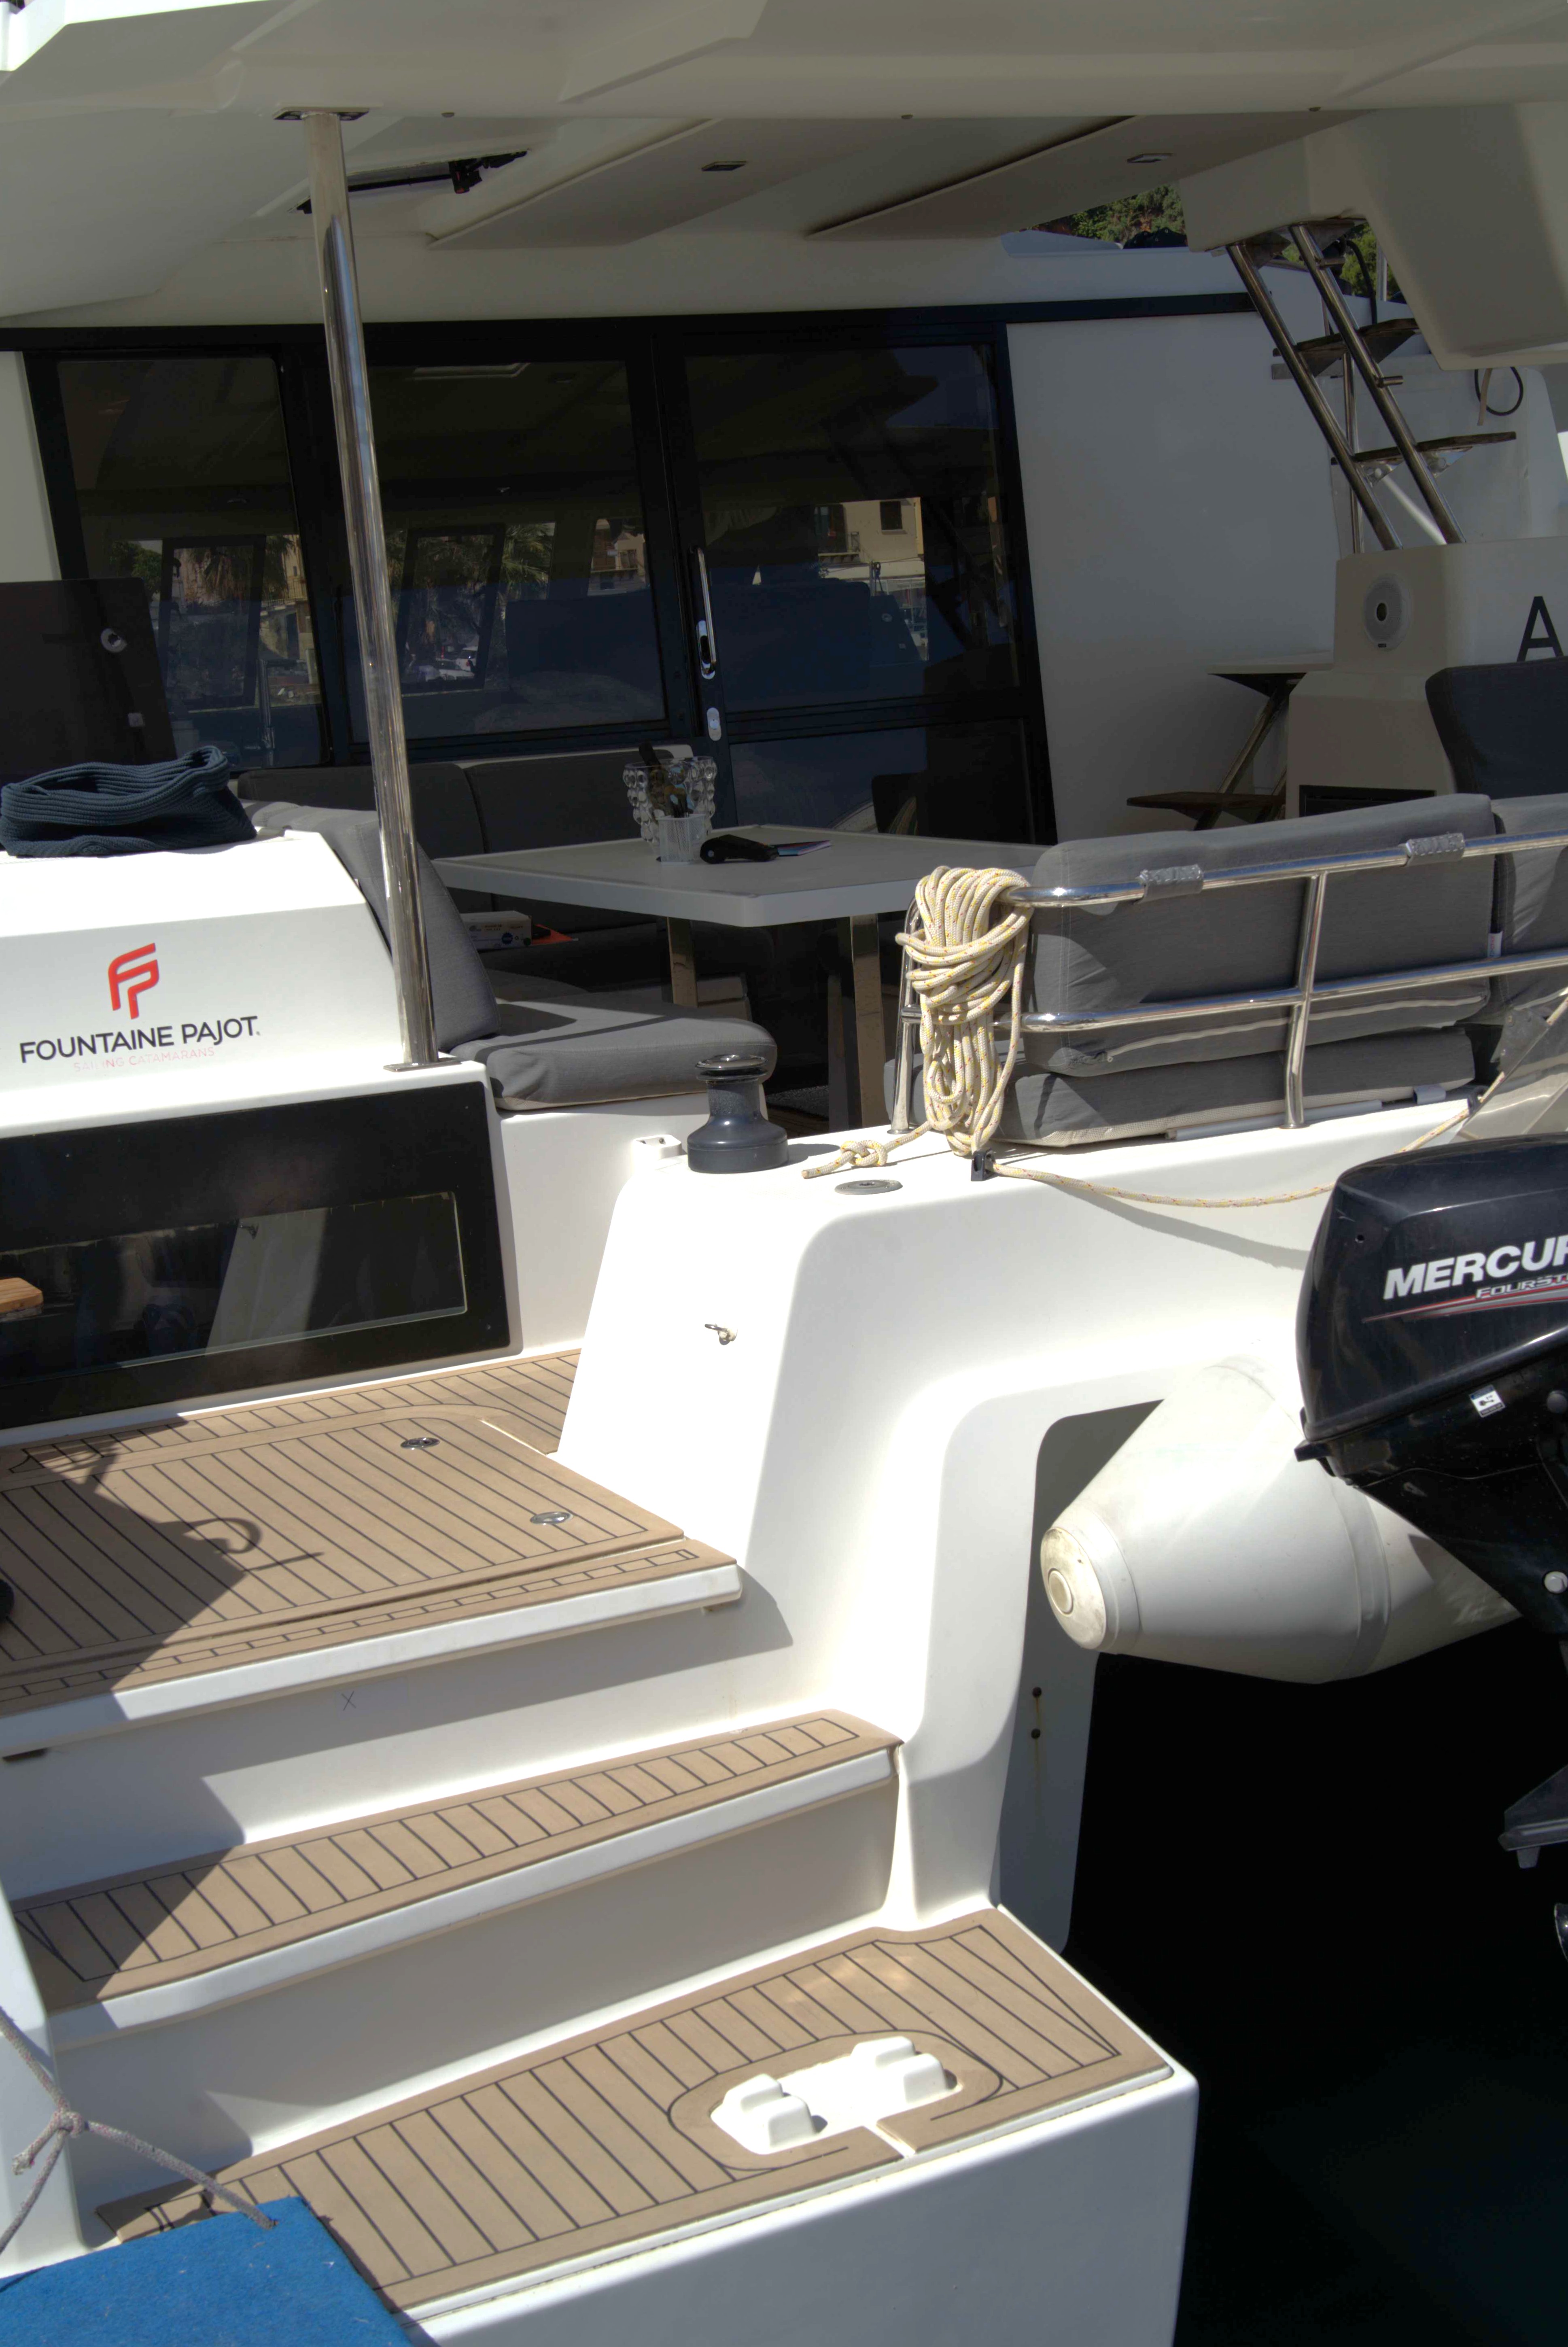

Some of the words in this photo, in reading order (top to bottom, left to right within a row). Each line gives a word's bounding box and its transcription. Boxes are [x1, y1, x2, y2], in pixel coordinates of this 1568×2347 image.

[1517, 596, 1564, 663] A
[19, 1025, 174, 1063] FOUNTAINE
[128, 1046, 215, 1066] CATAMARANS
[1476, 1273, 1568, 1299] FOURST
